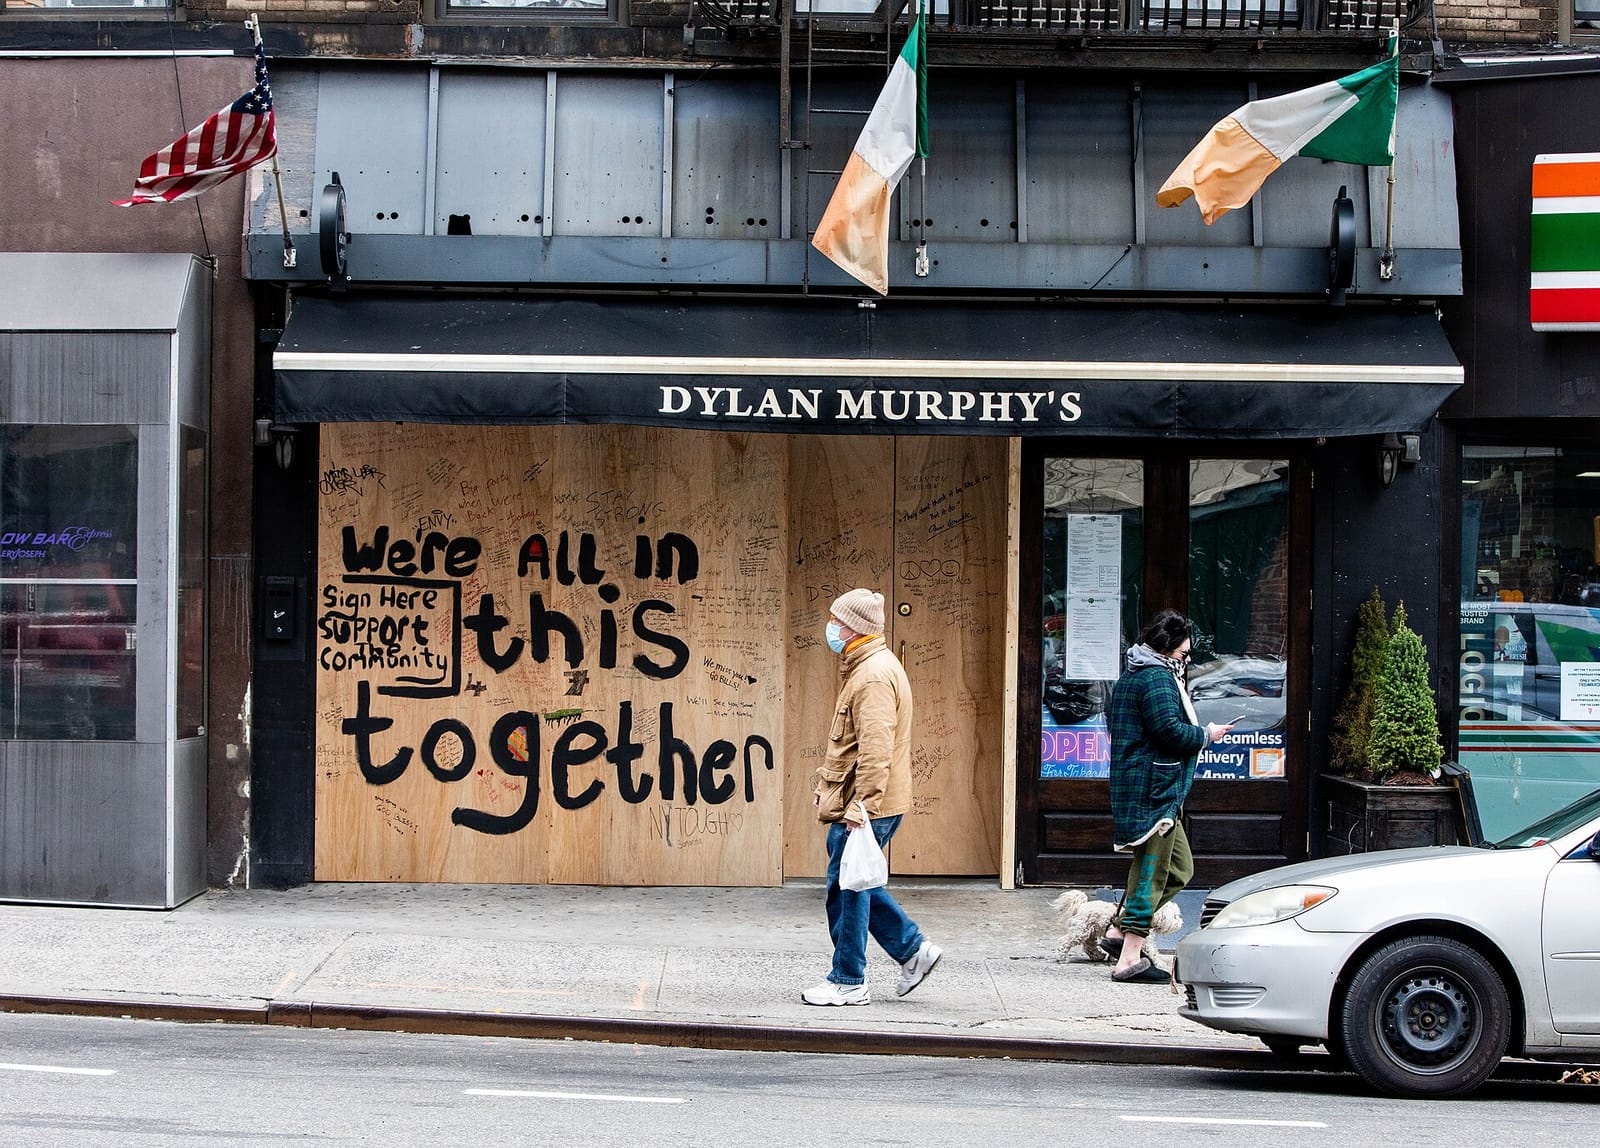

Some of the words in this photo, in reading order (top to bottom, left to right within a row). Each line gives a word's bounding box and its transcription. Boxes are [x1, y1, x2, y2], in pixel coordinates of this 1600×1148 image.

[659, 385, 822, 420] DYLAN
[835, 389, 1082, 423] MURPHY'S
[586, 486, 638, 514] STAY
[594, 501, 667, 530] STRONG
[31, 533, 70, 545] BAR
[342, 525, 482, 577] We're
[323, 585, 370, 621] Sign
[380, 586, 438, 609] Here
[463, 583, 690, 680] this
[703, 655, 715, 668] We
[342, 681, 774, 836] together
[1198, 751, 1244, 766] elivery
[649, 804, 673, 848] NY
[674, 806, 729, 838] TOUGH
